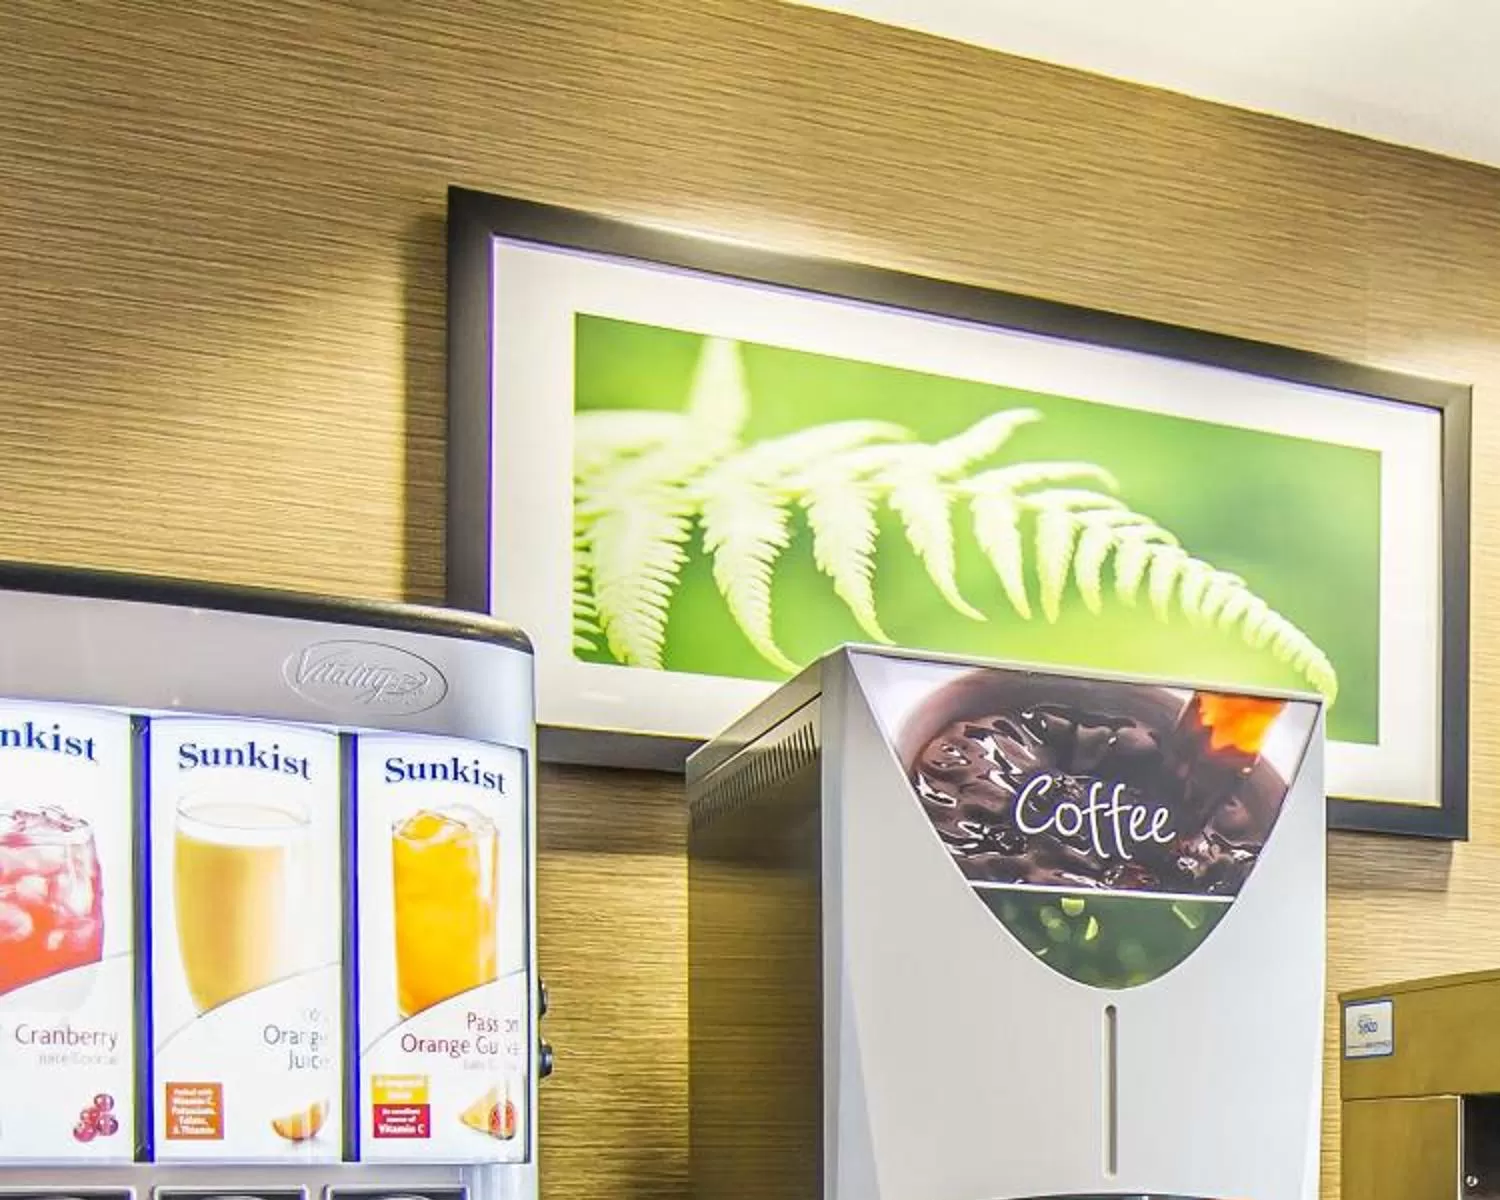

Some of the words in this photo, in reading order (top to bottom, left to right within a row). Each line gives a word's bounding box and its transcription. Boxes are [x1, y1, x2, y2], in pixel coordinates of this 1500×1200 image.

[0, 721, 99, 765] nkist
[178, 741, 311, 782] Sunkist
[385, 757, 506, 795] Sunkist
[1015, 774, 1177, 860] Coffee
[15, 1023, 119, 1050] Cranberry
[467, 1011, 520, 1033] Passon
[401, 1033, 471, 1058] Orange
